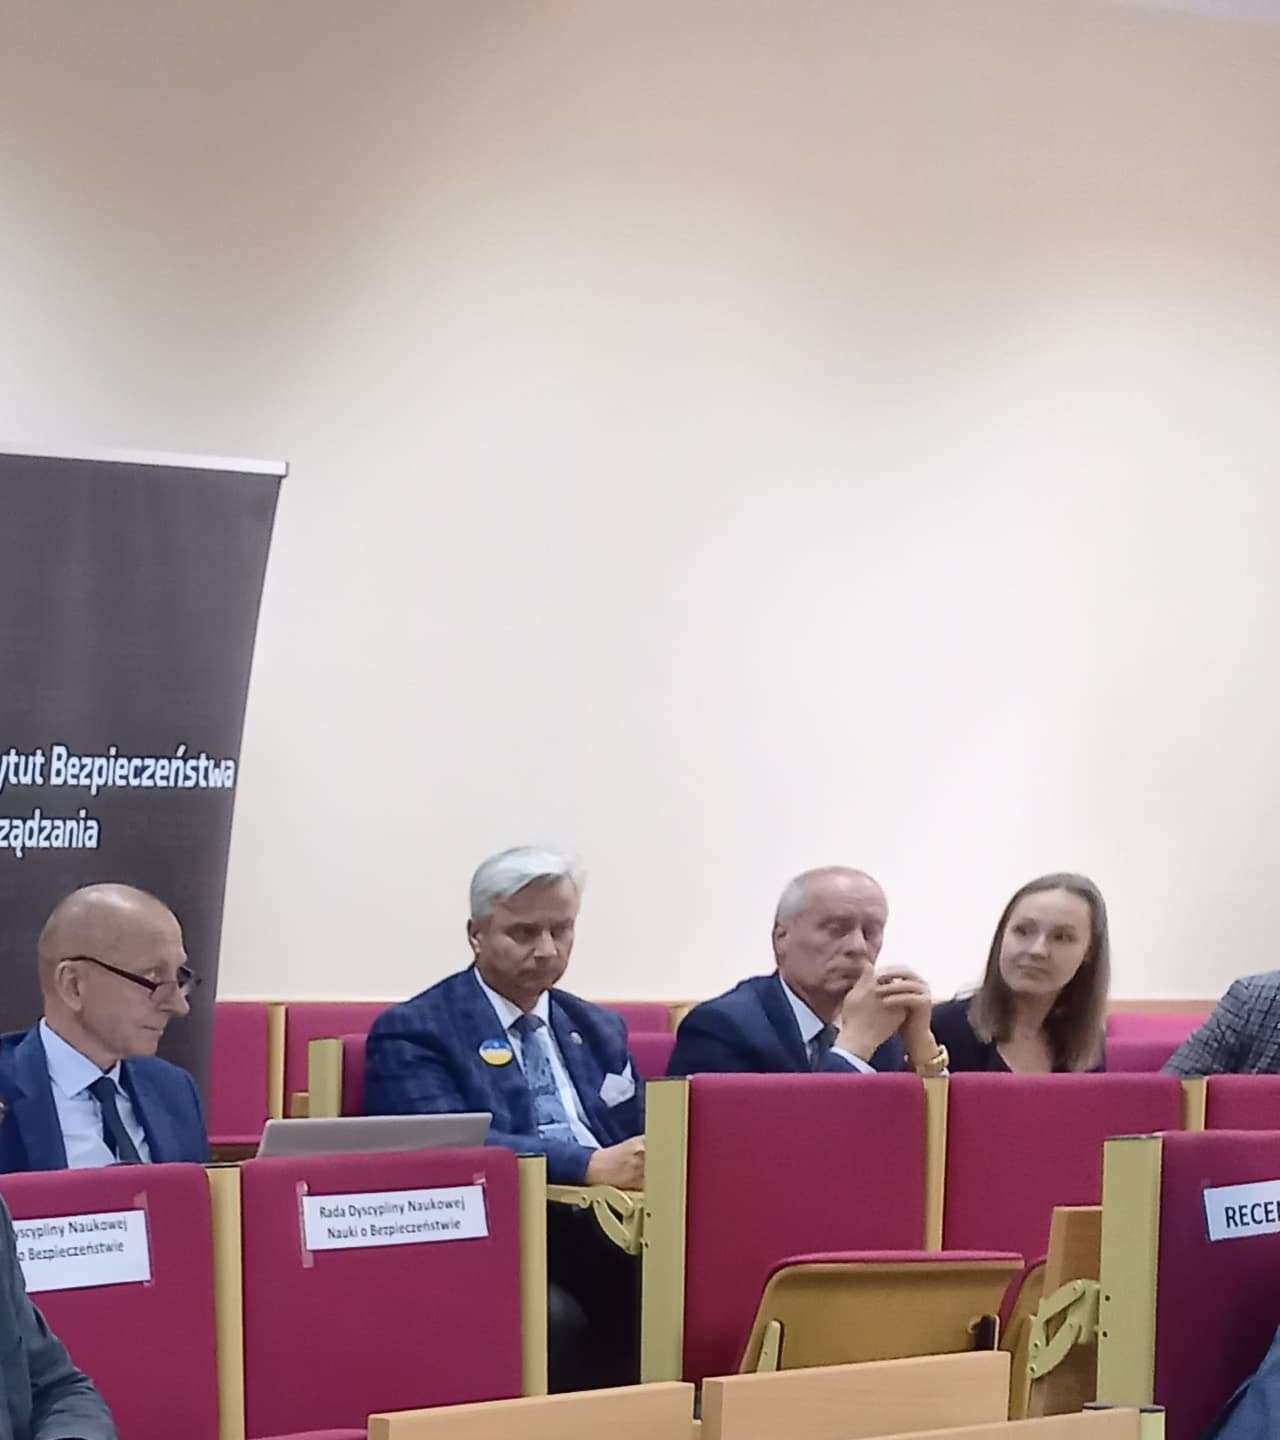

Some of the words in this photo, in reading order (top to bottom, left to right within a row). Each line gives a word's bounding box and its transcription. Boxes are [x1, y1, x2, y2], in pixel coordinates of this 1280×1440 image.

[49, 744, 237, 796] Bezpieczeństwa
[319, 1203, 346, 1219] Rada
[348, 1199, 405, 1219] Dyscypliny
[407, 1196, 466, 1213] Naukowej
[1224, 1200, 1280, 1229] RECE
[68, 1216, 128, 1233] Naukowej
[327, 1225, 358, 1240] Nauki
[360, 1227, 368, 1238] o
[370, 1218, 461, 1237] Bezpieczeństwie
[28, 1239, 125, 1261] Bezpieczeństwie
